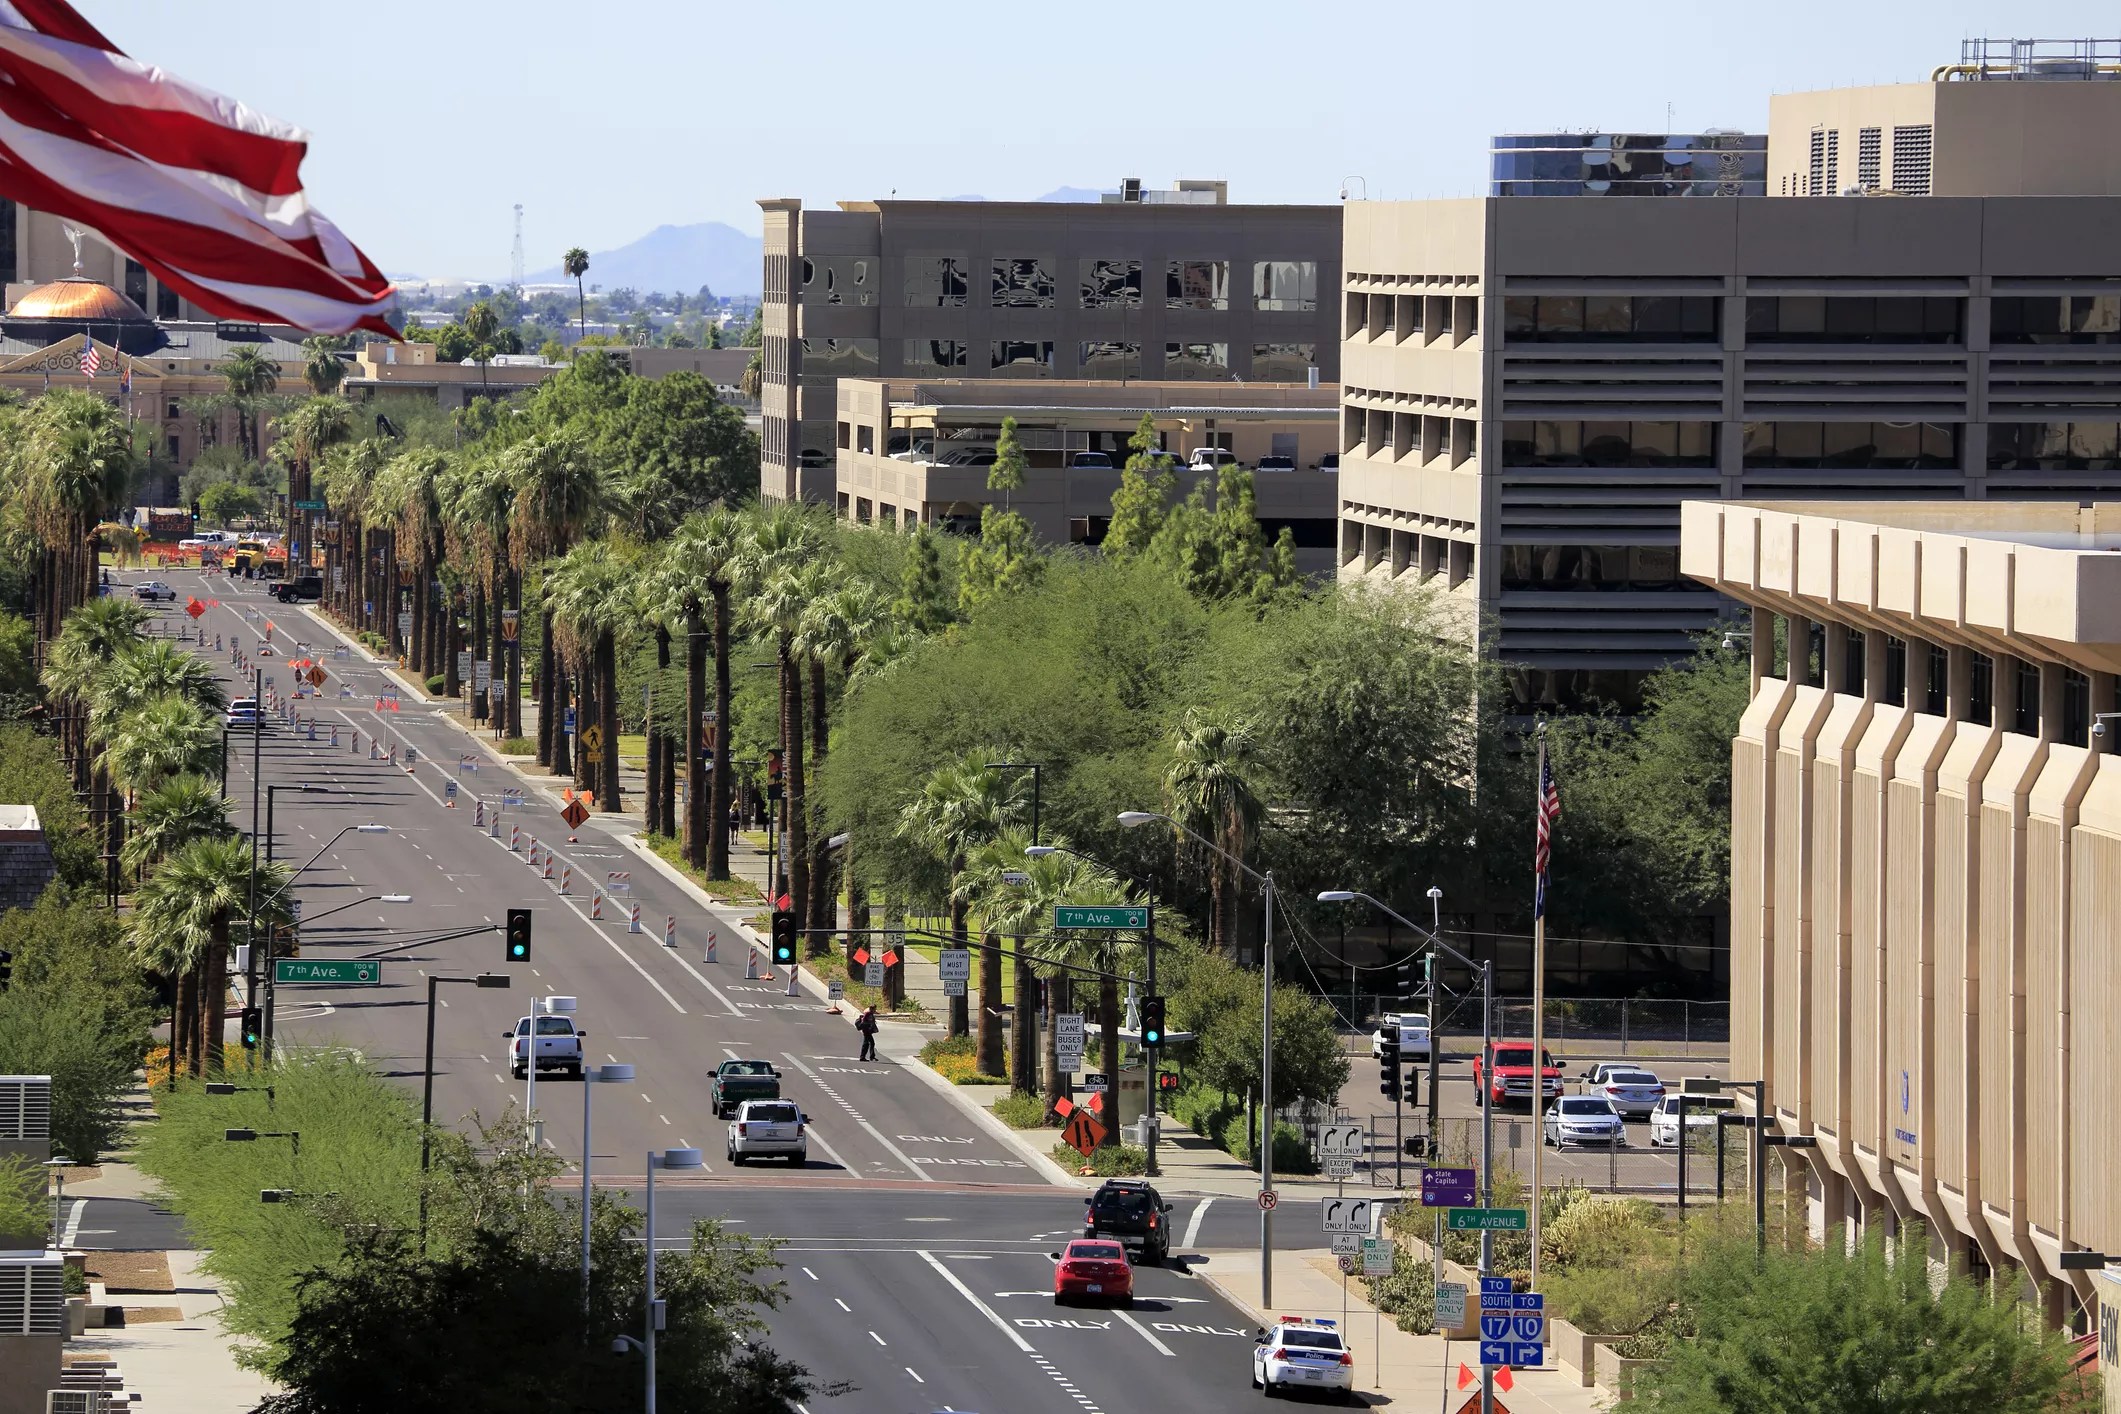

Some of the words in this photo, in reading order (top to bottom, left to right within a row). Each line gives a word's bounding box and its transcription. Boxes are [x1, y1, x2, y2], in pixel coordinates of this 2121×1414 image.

[1066, 912, 1083, 923] 7th
[1087, 912, 1114, 923] Ave.
[888, 934, 903, 944] 35
[287, 966, 307, 977] 7th
[310, 966, 341, 977] Ave.
[1058, 1036, 1081, 1044] BUSES
[819, 1066, 891, 1075] ONLY
[897, 1135, 976, 1144] ONLY
[911, 1157, 1028, 1168] BUSES
[1457, 1215, 1476, 1227] 6TH
[1480, 1217, 1517, 1227] AVENUE
[1489, 1280, 1504, 1290] TO
[1437, 1290, 1449, 1298] 30
[1482, 1296, 1511, 1307] SOUTH
[1520, 1297, 1536, 1307] TO
[1438, 1305, 1463, 1314] ONLY
[1014, 1318, 1112, 1330] ONLY
[1487, 1318, 1506, 1336] 17
[1518, 1318, 1538, 1336] 10
[1152, 1323, 1247, 1337] ONLY
[2101, 1302, 2119, 1368] FOX
[1305, 1352, 1325, 1360] Police
